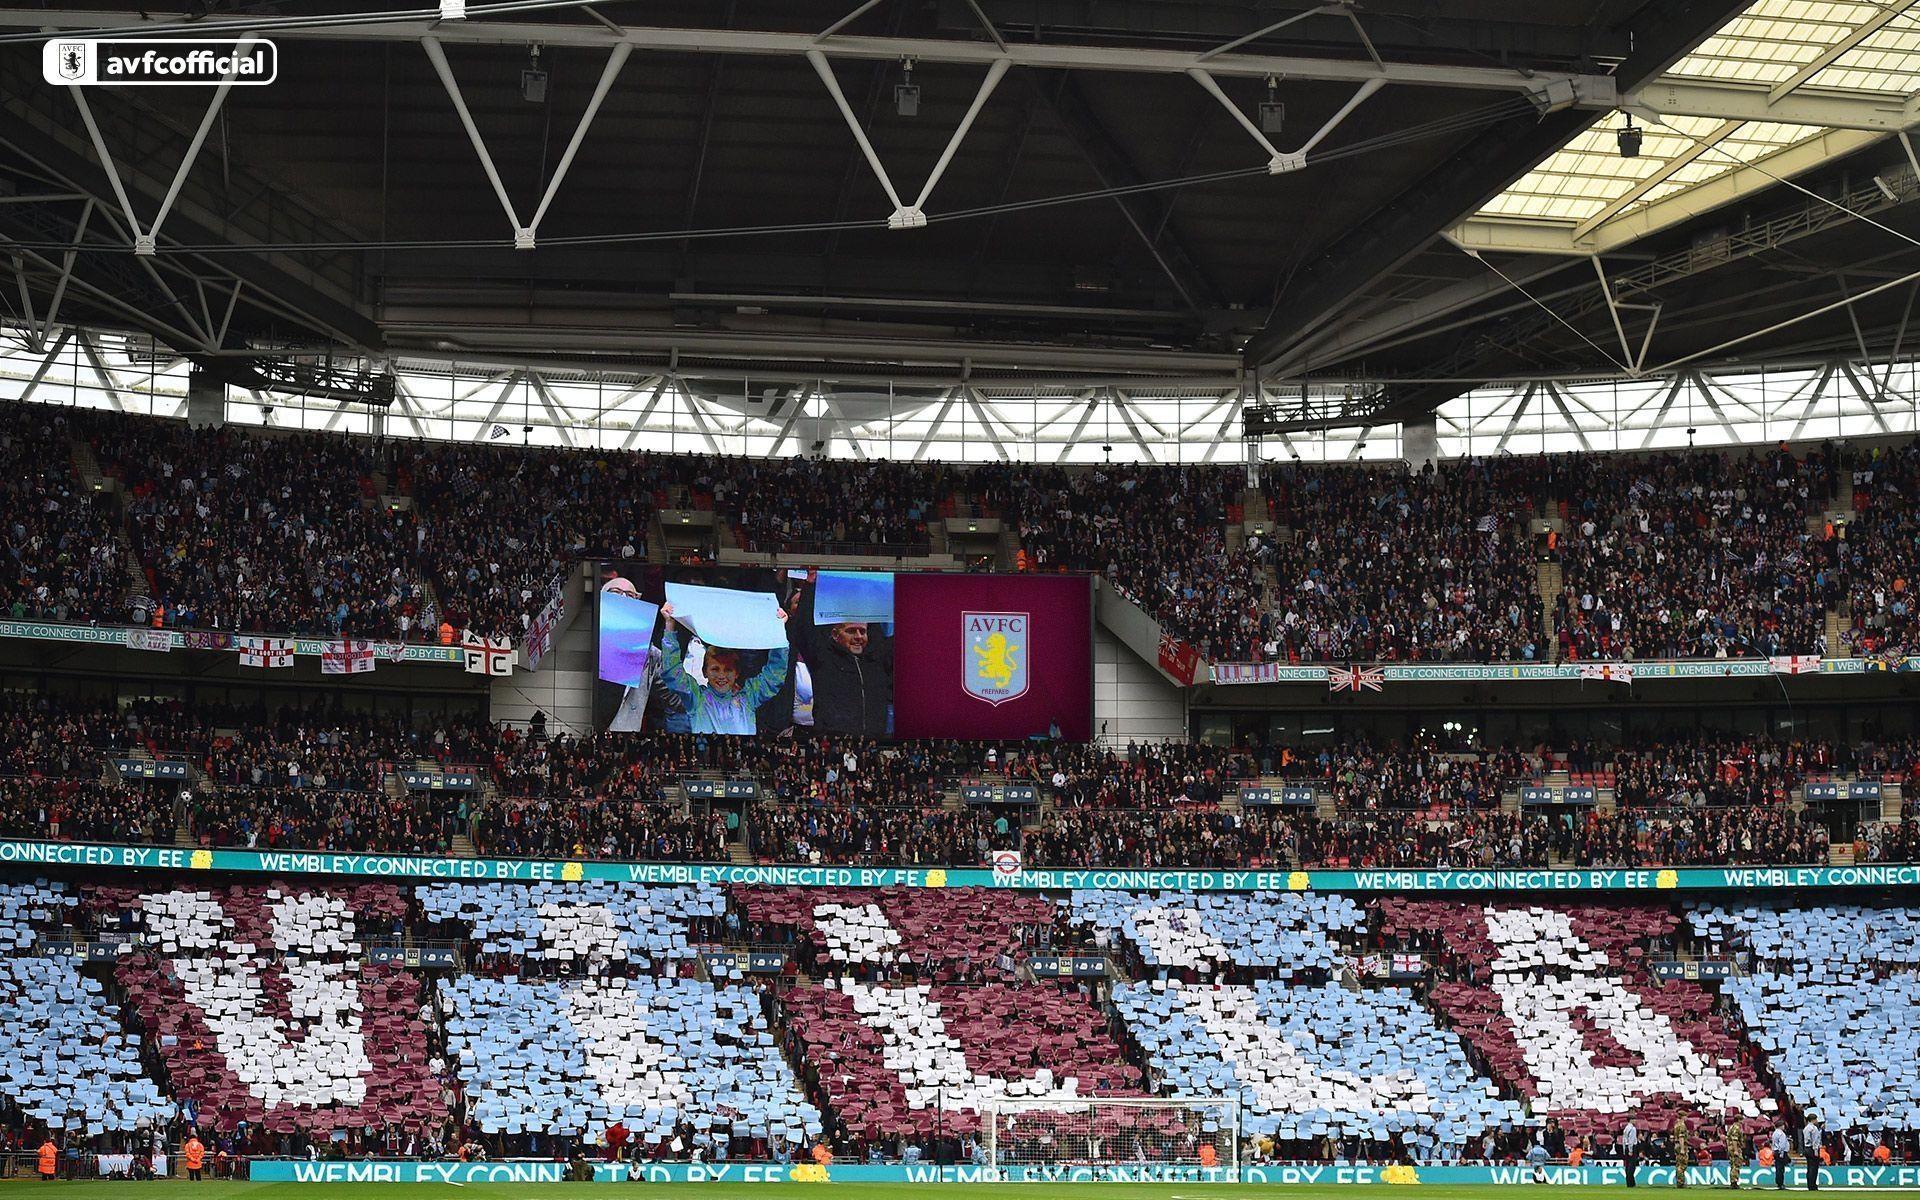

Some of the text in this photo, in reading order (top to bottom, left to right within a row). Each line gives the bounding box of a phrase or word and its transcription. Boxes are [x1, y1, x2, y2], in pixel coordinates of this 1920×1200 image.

[970, 618, 1022, 633] AVFC
[33, 626, 98, 639] CONNECTED
[100, 630, 114, 641] BY
[468, 634, 480, 644] A
[248, 639, 286, 649] A V
[278, 656, 285, 665] C
[418, 650, 432, 658] BY
[434, 651, 446, 659] EE
[468, 653, 506, 672] F C
[1418, 668, 1481, 678] CONNECTED
[1483, 668, 1496, 677] BY
[1497, 667, 1509, 677] EE
[1522, 666, 1572, 677] WEMBLEY
[1639, 665, 1653, 676] BY
[1654, 665, 1667, 675] EE
[1679, 664, 1729, 675] WEMBLEY
[0, 843, 113, 865] ONNECTED
[123, 848, 151, 866] BY
[158, 850, 184, 867] EE
[259, 852, 361, 873] WEMBLEY
[363, 856, 487, 878] CONNECTED
[497, 861, 524, 879] BY
[530, 862, 555, 880] EE
[629, 863, 726, 884] WEMBLEY
[730, 866, 852, 886] CONNECTED
[861, 868, 888, 886] BY
[894, 869, 919, 887] EE
[992, 870, 1090, 888] WEMBLEY
[1092, 870, 1214, 888] CONNECTED
[1223, 871, 1250, 888] BY
[1256, 872, 1281, 889] EE
[1354, 872, 1452, 889] WEMBLEY
[1455, 872, 1581, 889] CONNECTED
[1590, 871, 1617, 888] BY
[1624, 871, 1649, 888] EE
[1723, 868, 1823, 887] WEMBLEY
[687, 1163, 731, 1182] BY
[1282, 1166, 1324, 1184] BY
[1847, 1166, 1886, 1186] BY
[1899, 1168, 1920, 1186] E
